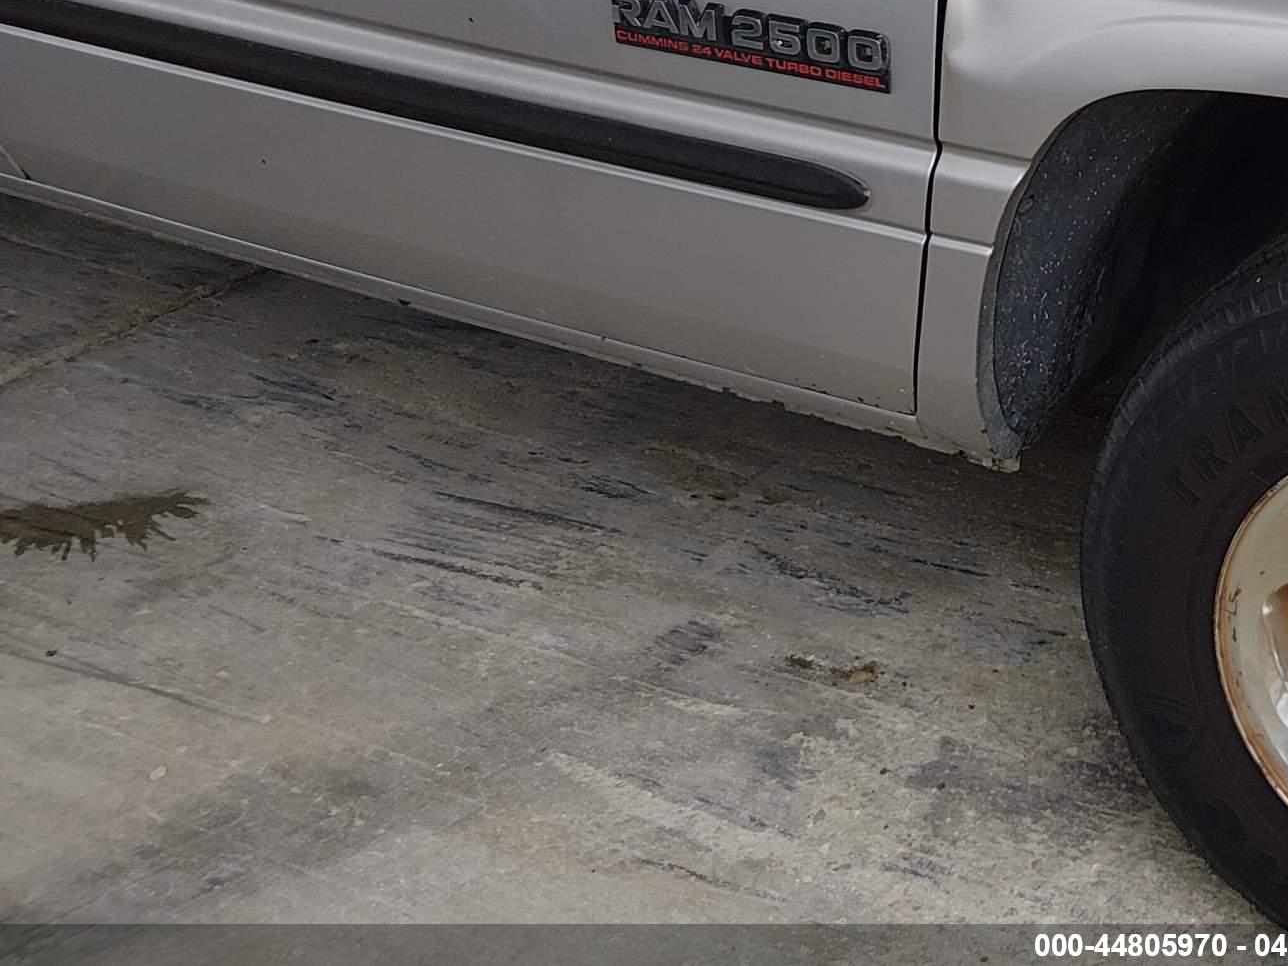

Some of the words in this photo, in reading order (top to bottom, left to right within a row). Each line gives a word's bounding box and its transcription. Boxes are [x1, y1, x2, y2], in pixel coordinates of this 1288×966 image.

[615, 30, 690, 52] CUMMINS
[691, 44, 713, 56] 24
[714, 48, 763, 66] VALVE
[765, 56, 822, 76] TURBO
[824, 68, 887, 88] DIESEL
[731, 8, 891, 71] 2500
